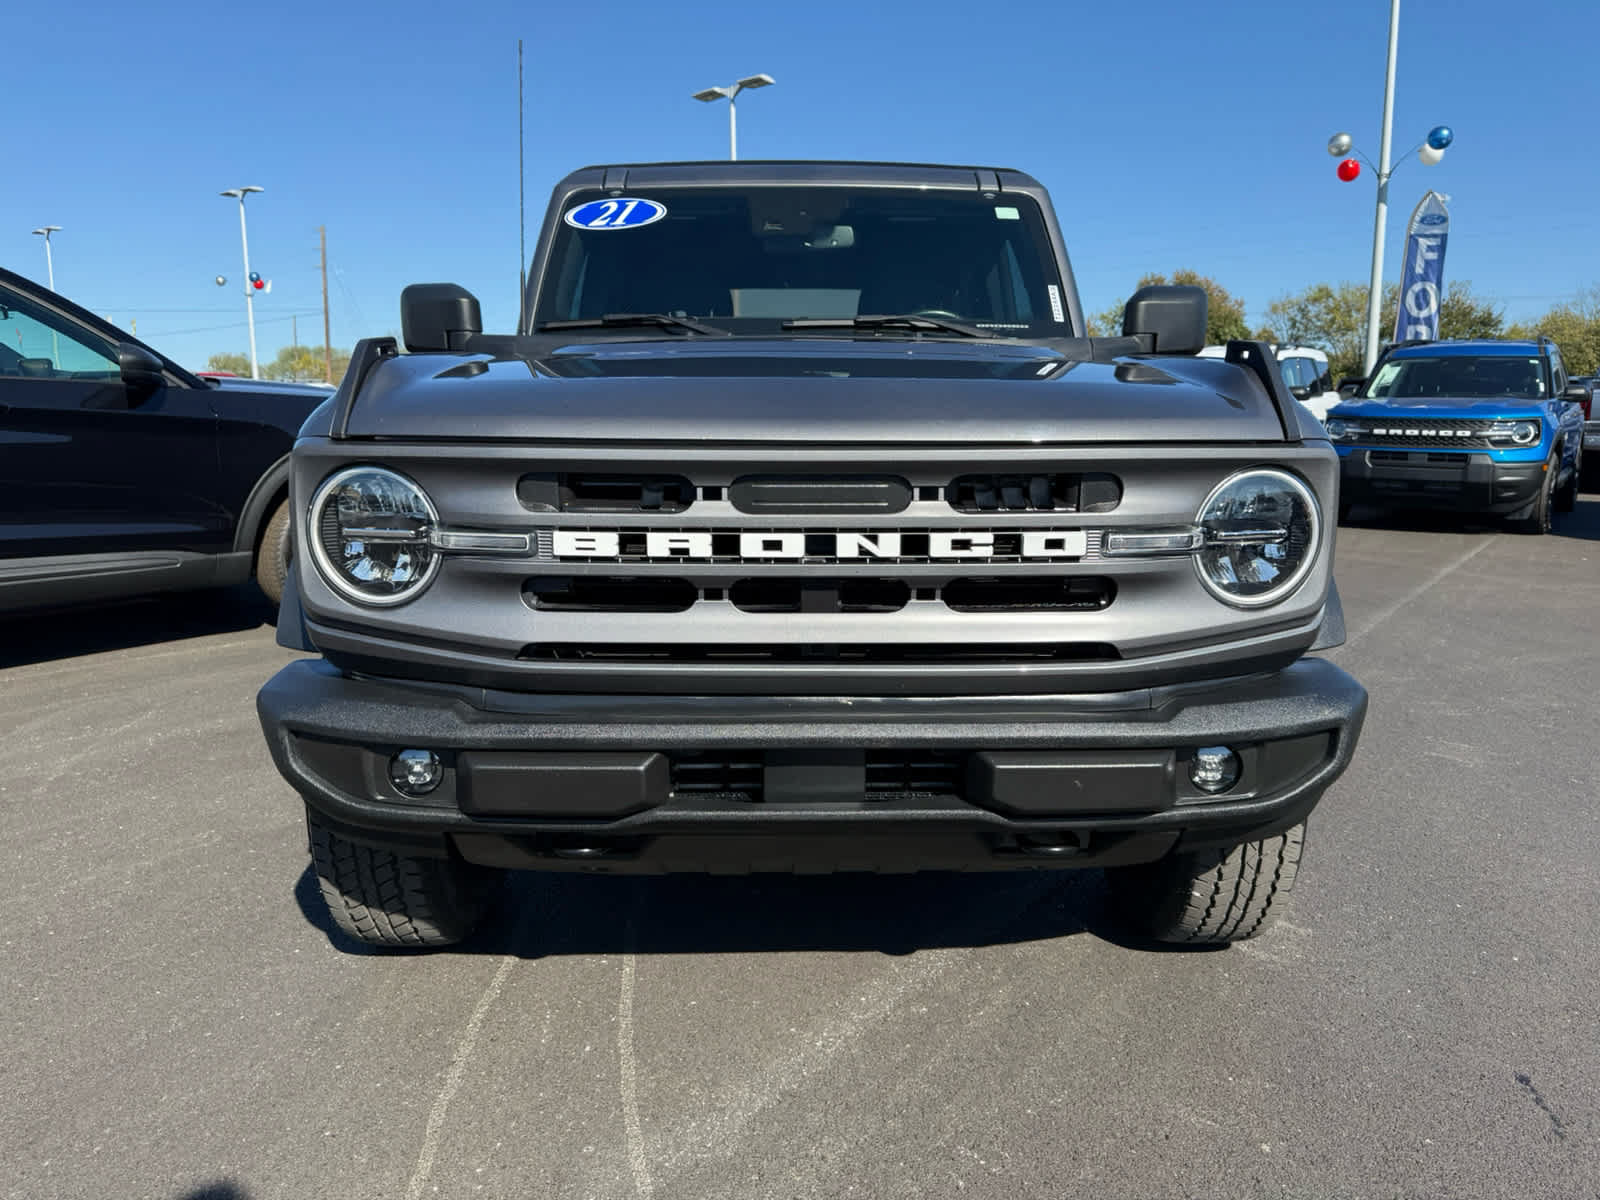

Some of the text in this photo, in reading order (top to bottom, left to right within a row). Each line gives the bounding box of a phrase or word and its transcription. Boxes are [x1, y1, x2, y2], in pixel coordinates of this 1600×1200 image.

[588, 201, 640, 227] 21
[1372, 428, 1472, 437] BRONCO
[552, 531, 1088, 558] BRONCO
